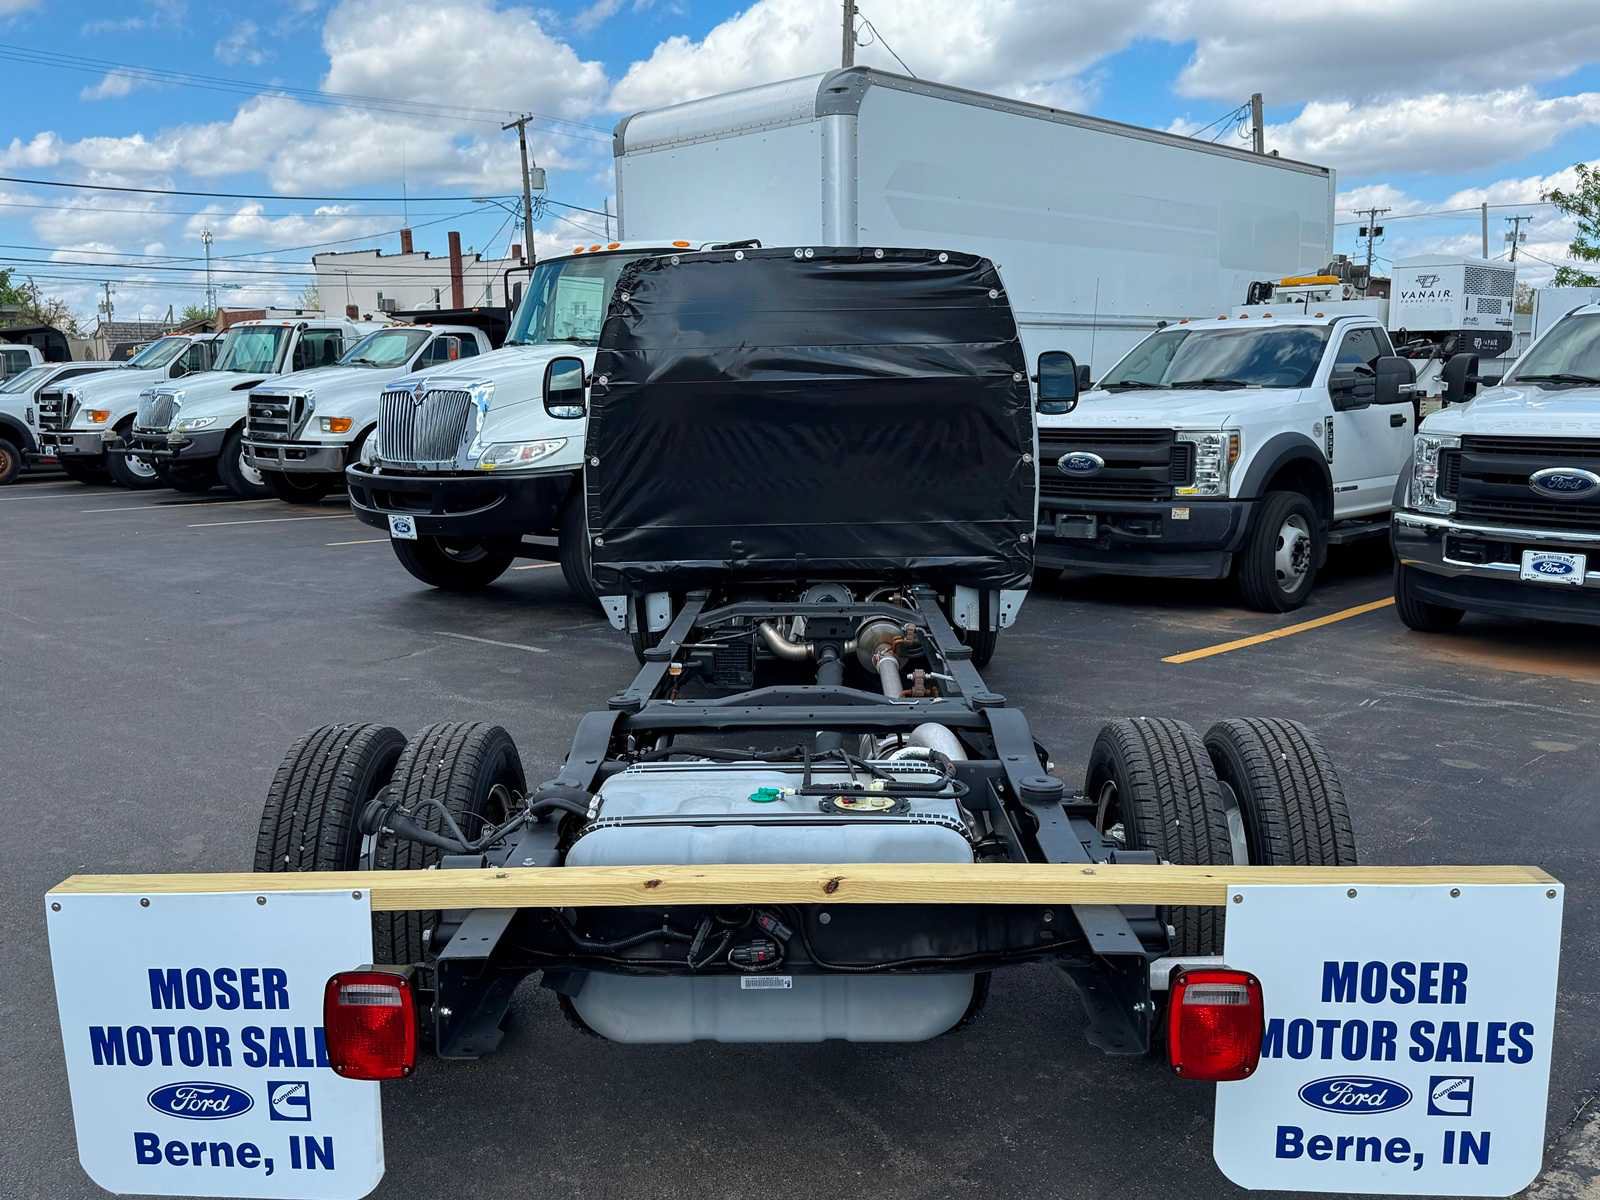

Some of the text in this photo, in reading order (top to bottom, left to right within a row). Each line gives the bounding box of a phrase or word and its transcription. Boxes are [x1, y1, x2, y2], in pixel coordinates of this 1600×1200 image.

[1401, 289, 1451, 299] VANAIR
[1068, 457, 1091, 469] Ford
[1547, 475, 1582, 489] Ford
[1540, 561, 1566, 573] Ford
[147, 967, 290, 1011] MOSER
[1321, 960, 1468, 1005] MOSER
[88, 1025, 233, 1068] MOTOR
[1261, 1018, 1535, 1065] MOTOR SALES
[171, 1086, 231, 1112] Ford
[1322, 1080, 1389, 1106] Ford
[133, 1131, 335, 1177] Berne, IN
[1275, 1125, 1491, 1172] Berne, IN
